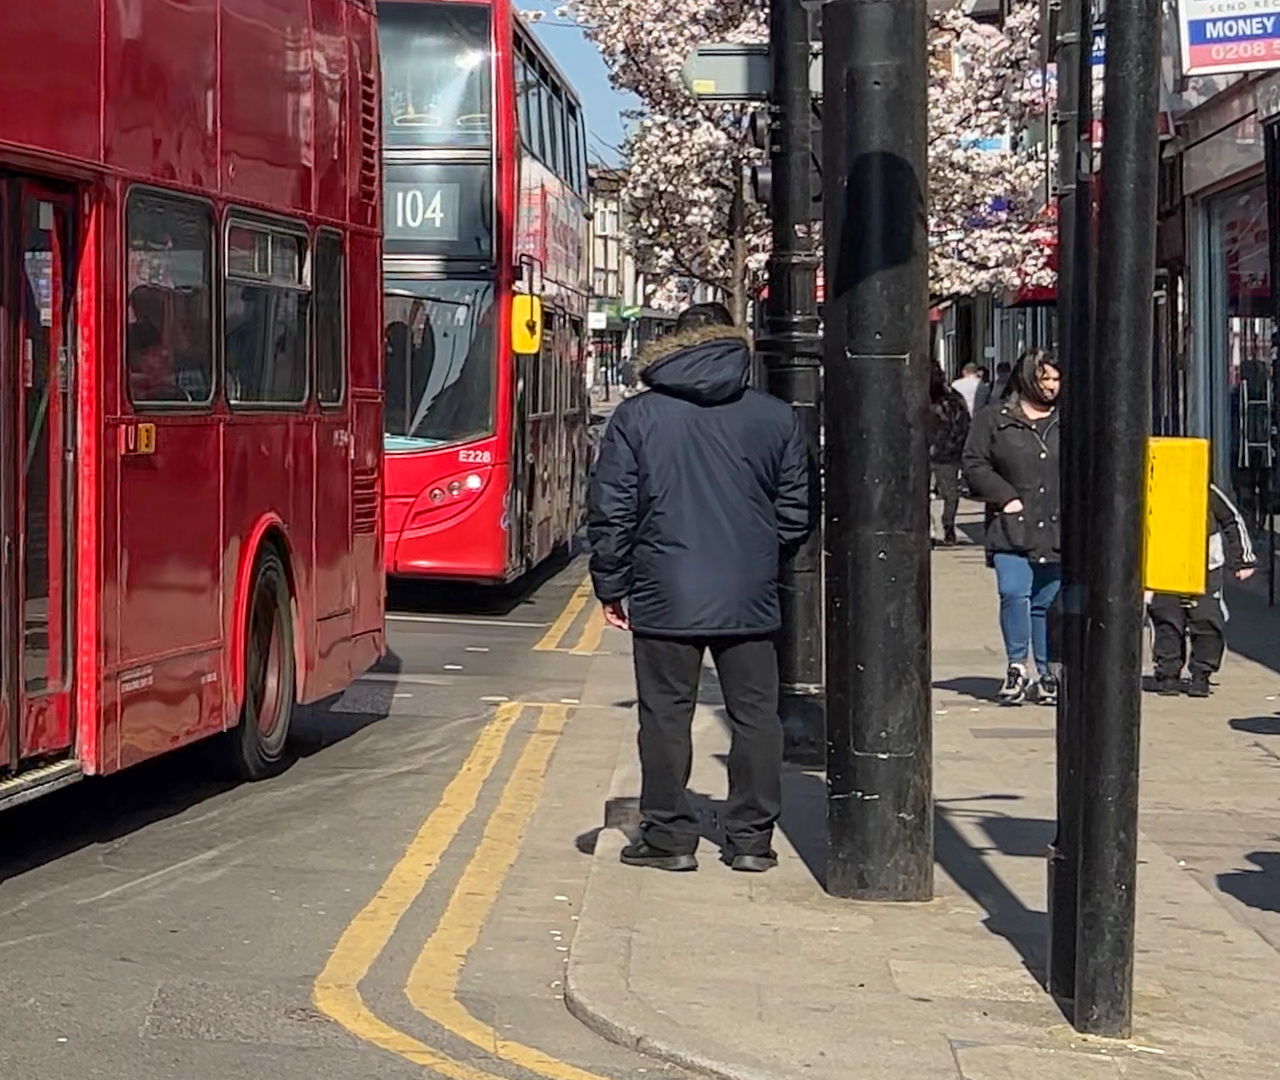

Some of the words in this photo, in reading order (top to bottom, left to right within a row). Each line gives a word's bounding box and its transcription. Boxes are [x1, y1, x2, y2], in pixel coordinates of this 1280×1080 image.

[1206, 16, 1276, 39] MONEY
[1211, 41, 1266, 60] 0208
[397, 190, 444, 227] 104
[458, 450, 491, 463] E228
